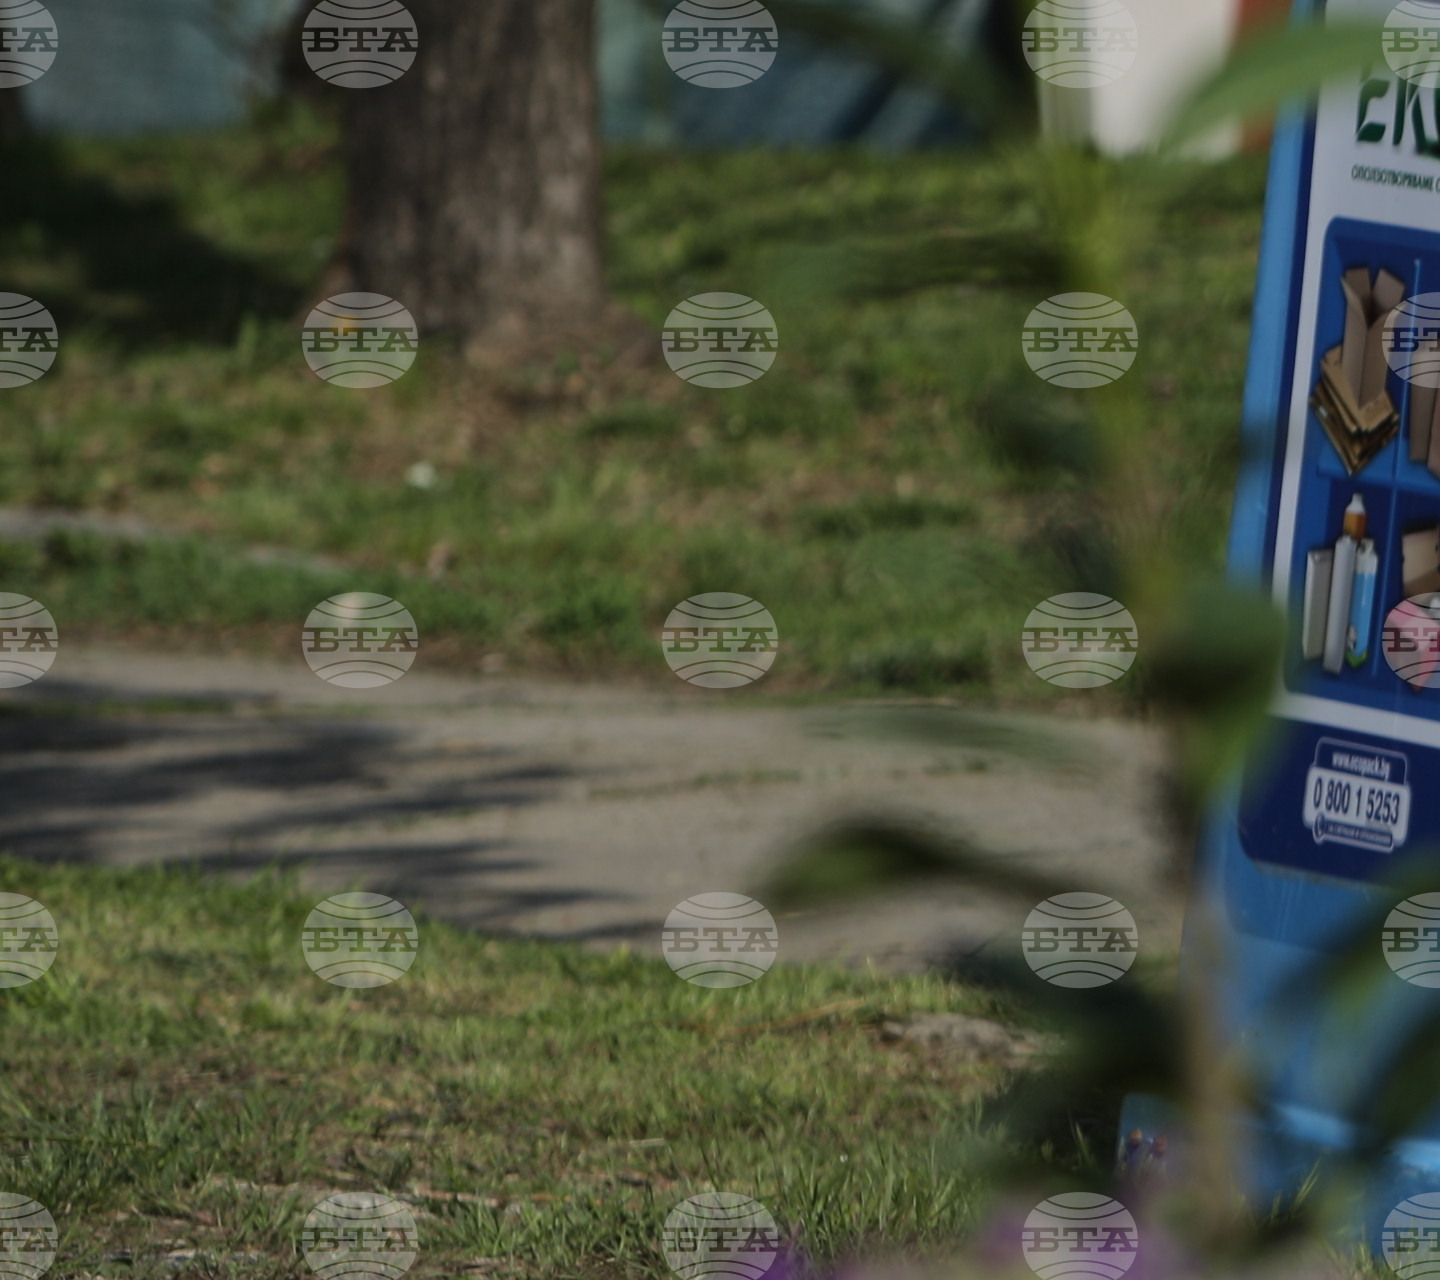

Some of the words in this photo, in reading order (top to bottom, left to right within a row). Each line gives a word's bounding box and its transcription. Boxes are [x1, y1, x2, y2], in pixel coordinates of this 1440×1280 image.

[1314, 777, 1322, 808] 0
[1326, 778, 1350, 814] 800
[1356, 785, 1362, 817] 1
[1366, 788, 1400, 824] 5253
